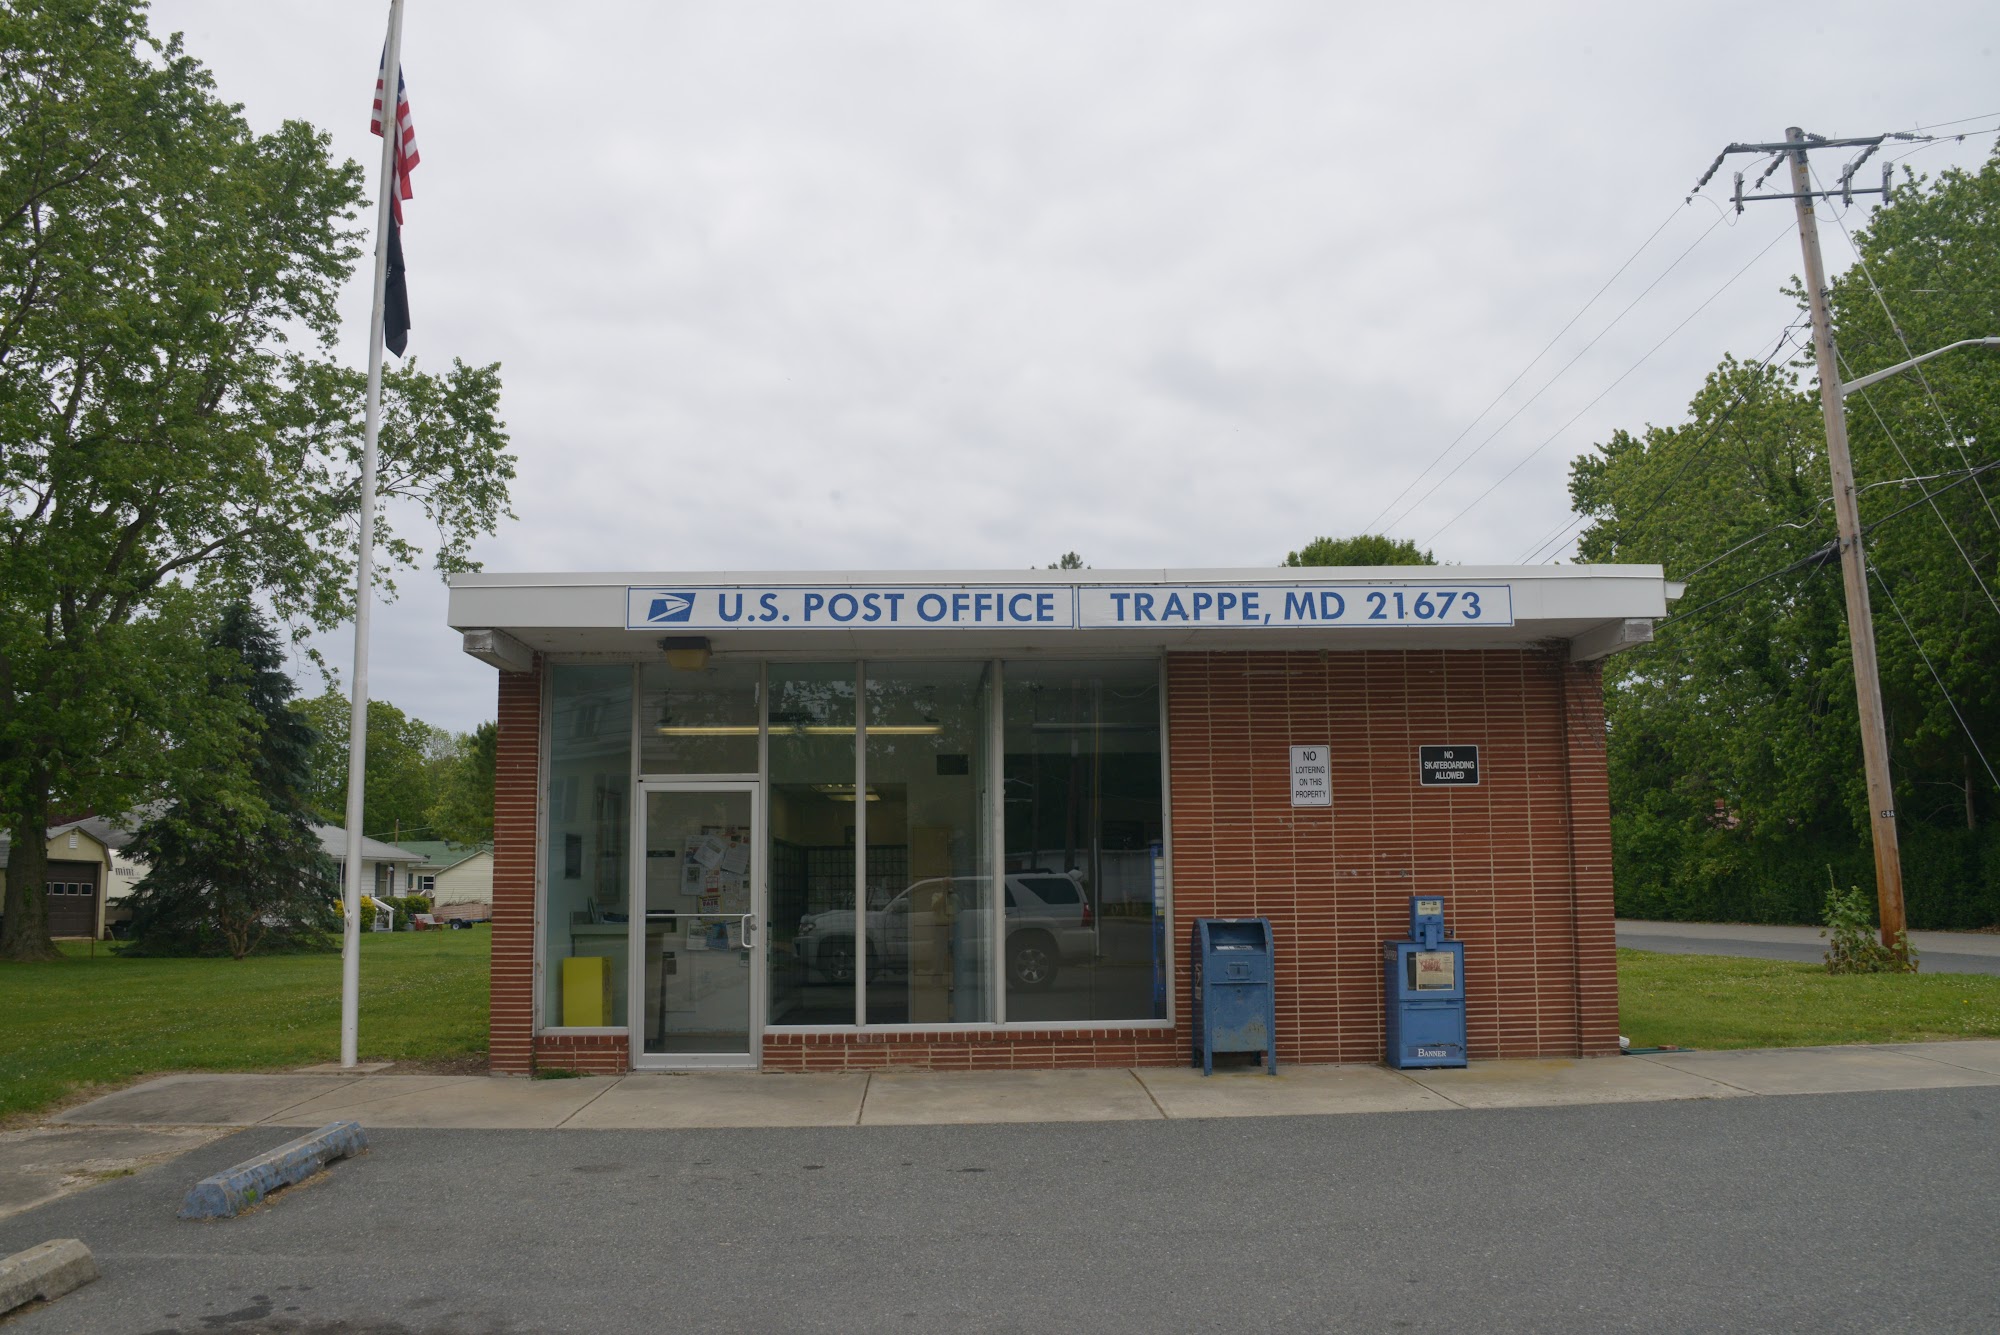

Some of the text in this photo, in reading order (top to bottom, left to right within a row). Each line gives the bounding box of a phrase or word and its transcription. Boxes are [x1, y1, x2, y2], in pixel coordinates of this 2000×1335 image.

[718, 593, 1053, 622] U.S. POST OFFICE
[1110, 591, 1482, 625] TRAPPE, MD 21673
[1303, 751, 1317, 761] NO
[1443, 750, 1454, 759] NO
[1295, 766, 1326, 774] LOITERING
[1424, 761, 1475, 770] SKATEBOARDING
[1435, 771, 1465, 780] ALLOWED
[1299, 778, 1308, 786] ON
[1295, 790, 1327, 799] PROPERTY
[1417, 1048, 1447, 1058] BANNER
